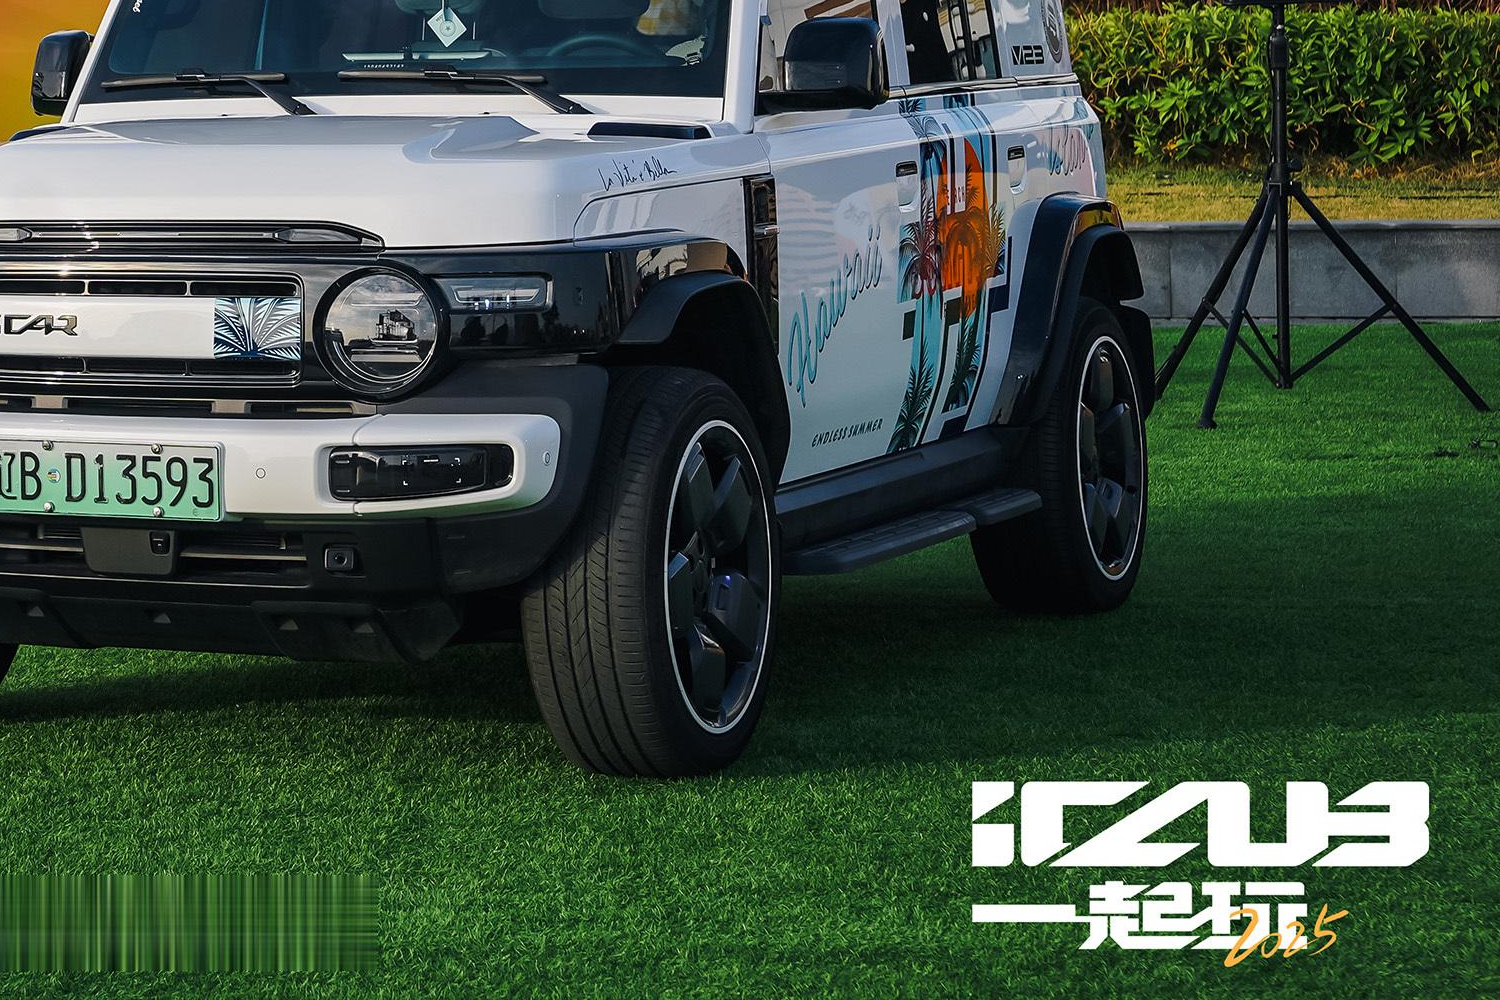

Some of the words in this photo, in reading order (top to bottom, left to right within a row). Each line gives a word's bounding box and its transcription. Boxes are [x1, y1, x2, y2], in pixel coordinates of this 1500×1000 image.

[787, 223, 883, 409] Hawaii
[811, 425, 848, 448] ENDLESS
[848, 418, 884, 440] SUMMER
